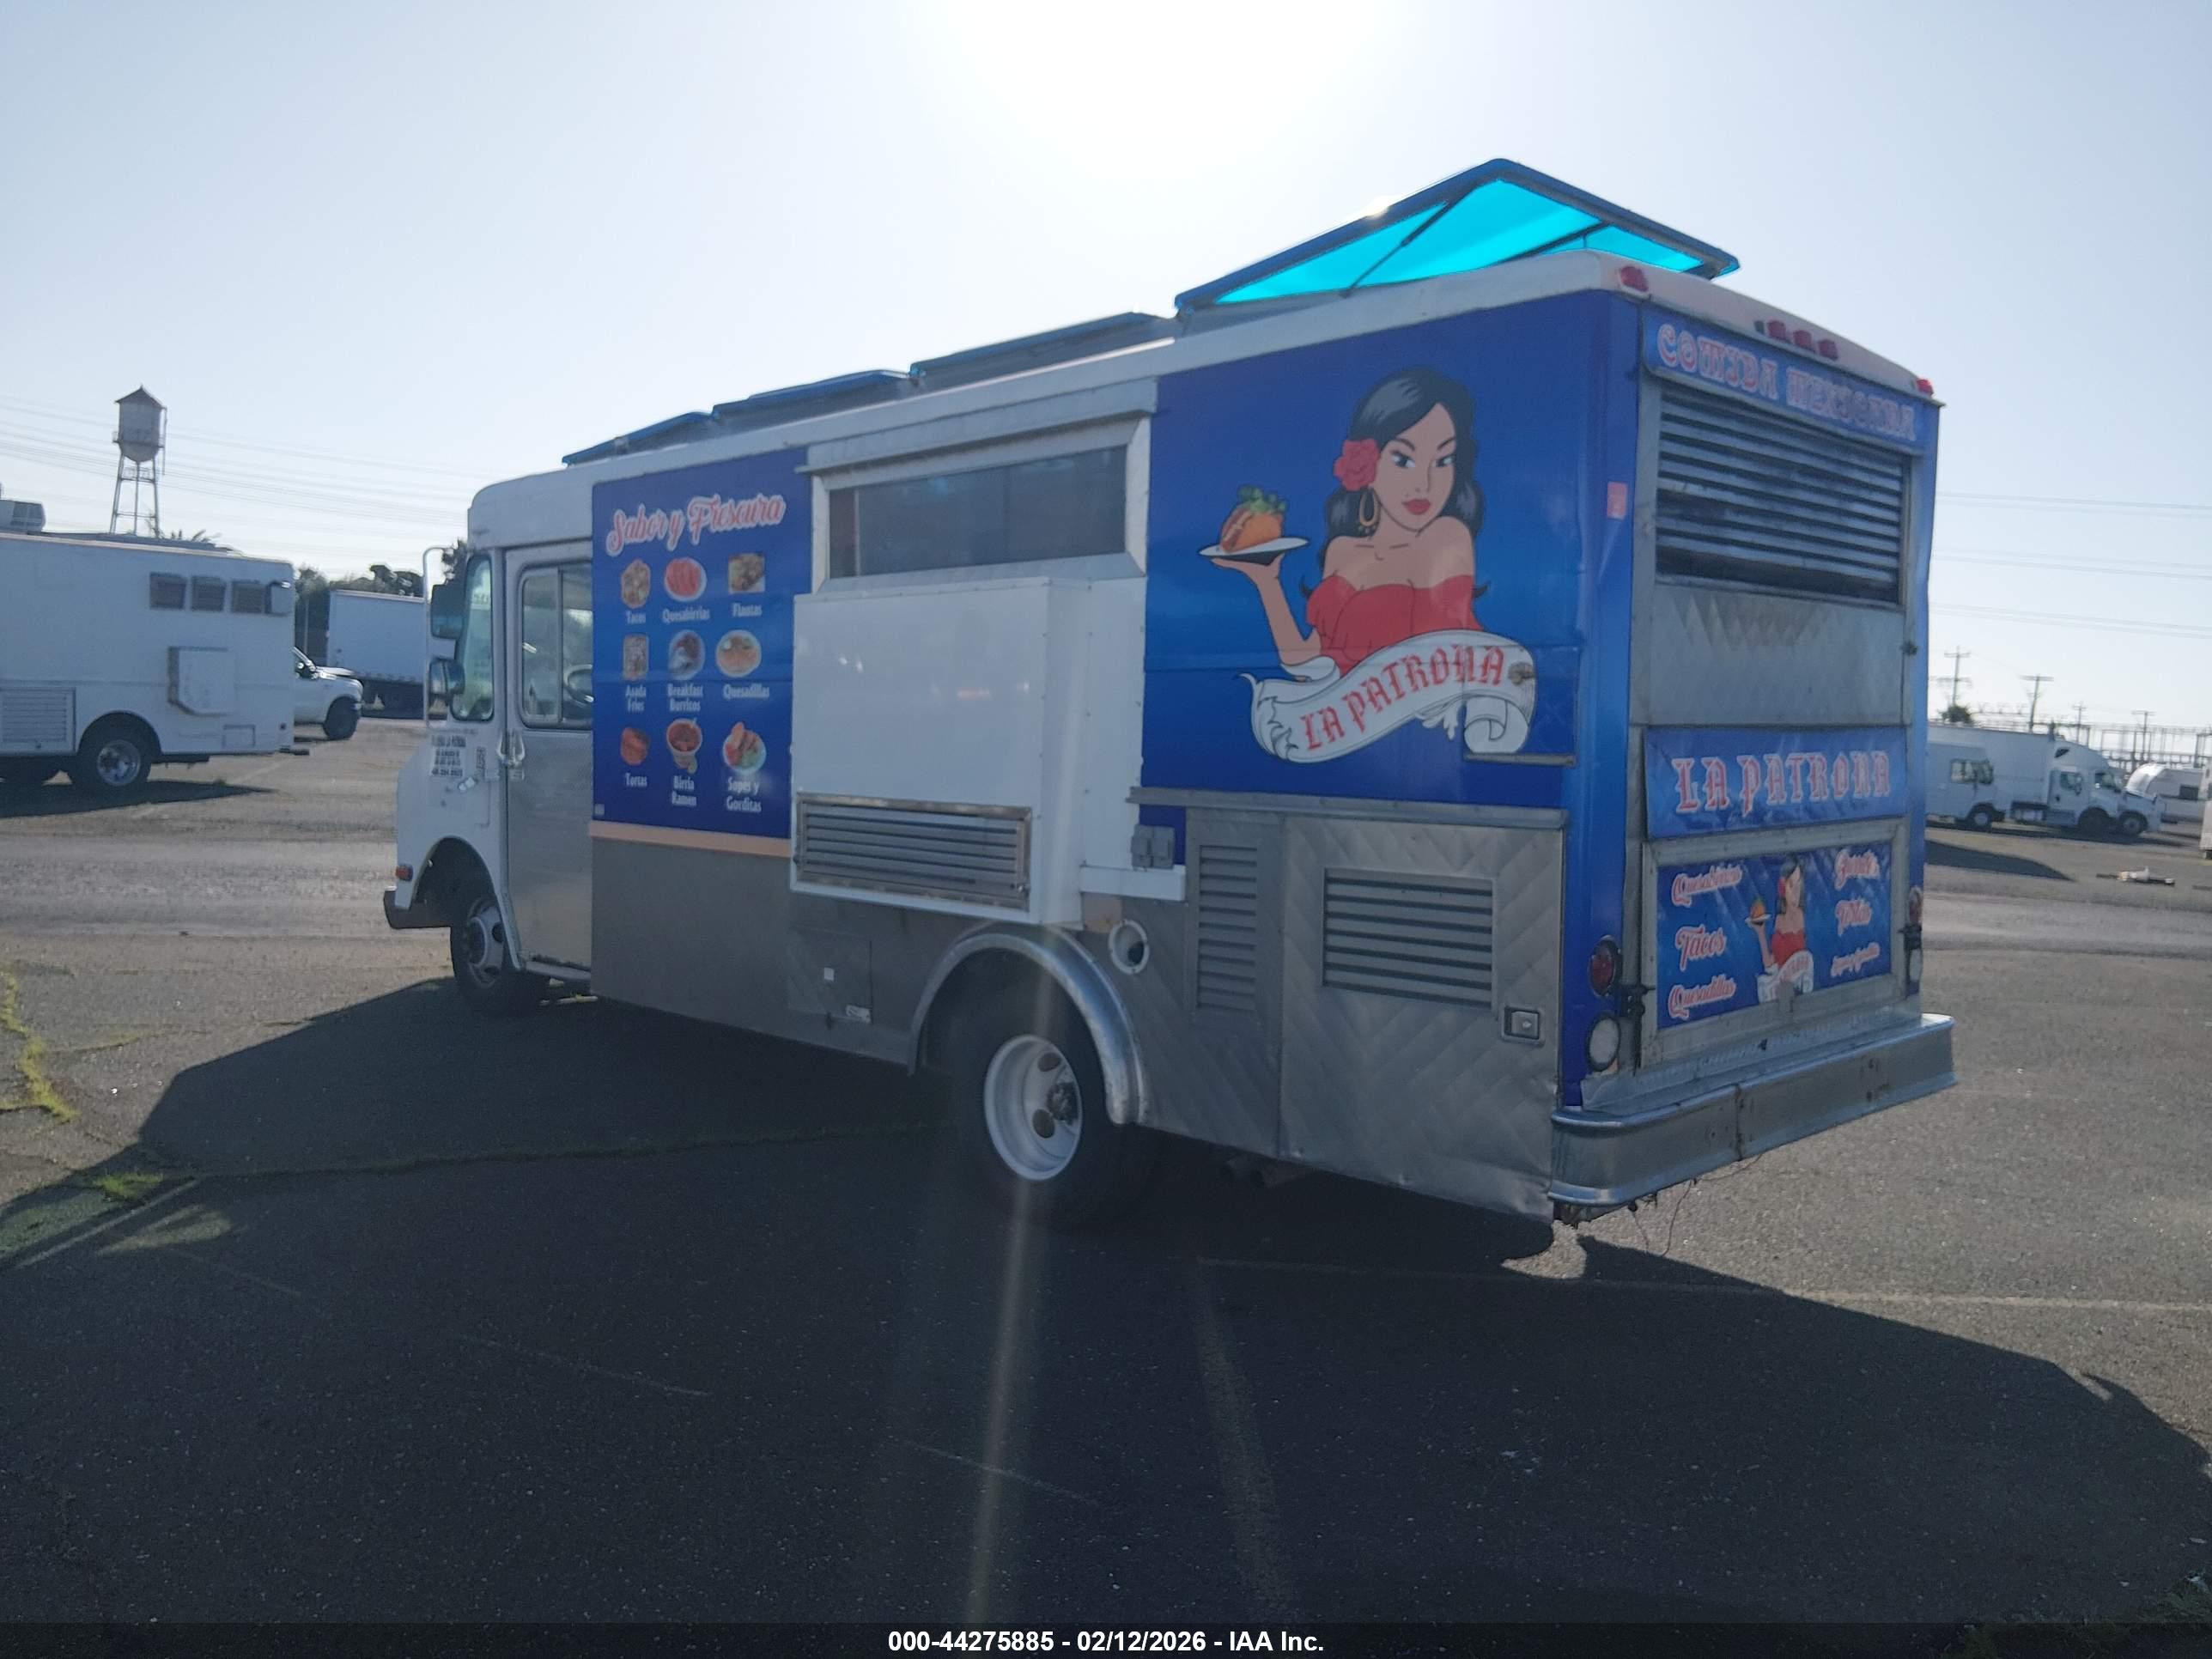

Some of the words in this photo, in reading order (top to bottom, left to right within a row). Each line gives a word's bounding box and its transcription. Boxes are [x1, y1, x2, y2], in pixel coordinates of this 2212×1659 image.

[607, 504, 666, 556] Sabor
[667, 509, 685, 551] y
[667, 684, 703, 697] Breakfast
[723, 684, 769, 699] Quesadillas
[1299, 706, 1346, 751] LA
[1342, 644, 1504, 732] PATRONA
[626, 773, 647, 787] Tortas
[673, 775, 695, 790] Birria
[1673, 757, 1729, 811] LA
[1737, 750, 1889, 817] PATRONA
[672, 791, 696, 806] Ramen
[726, 798, 762, 813] Gorditas
[1675, 925, 1726, 972] Tacos
[1669, 974, 1735, 1018] Quesadillas
